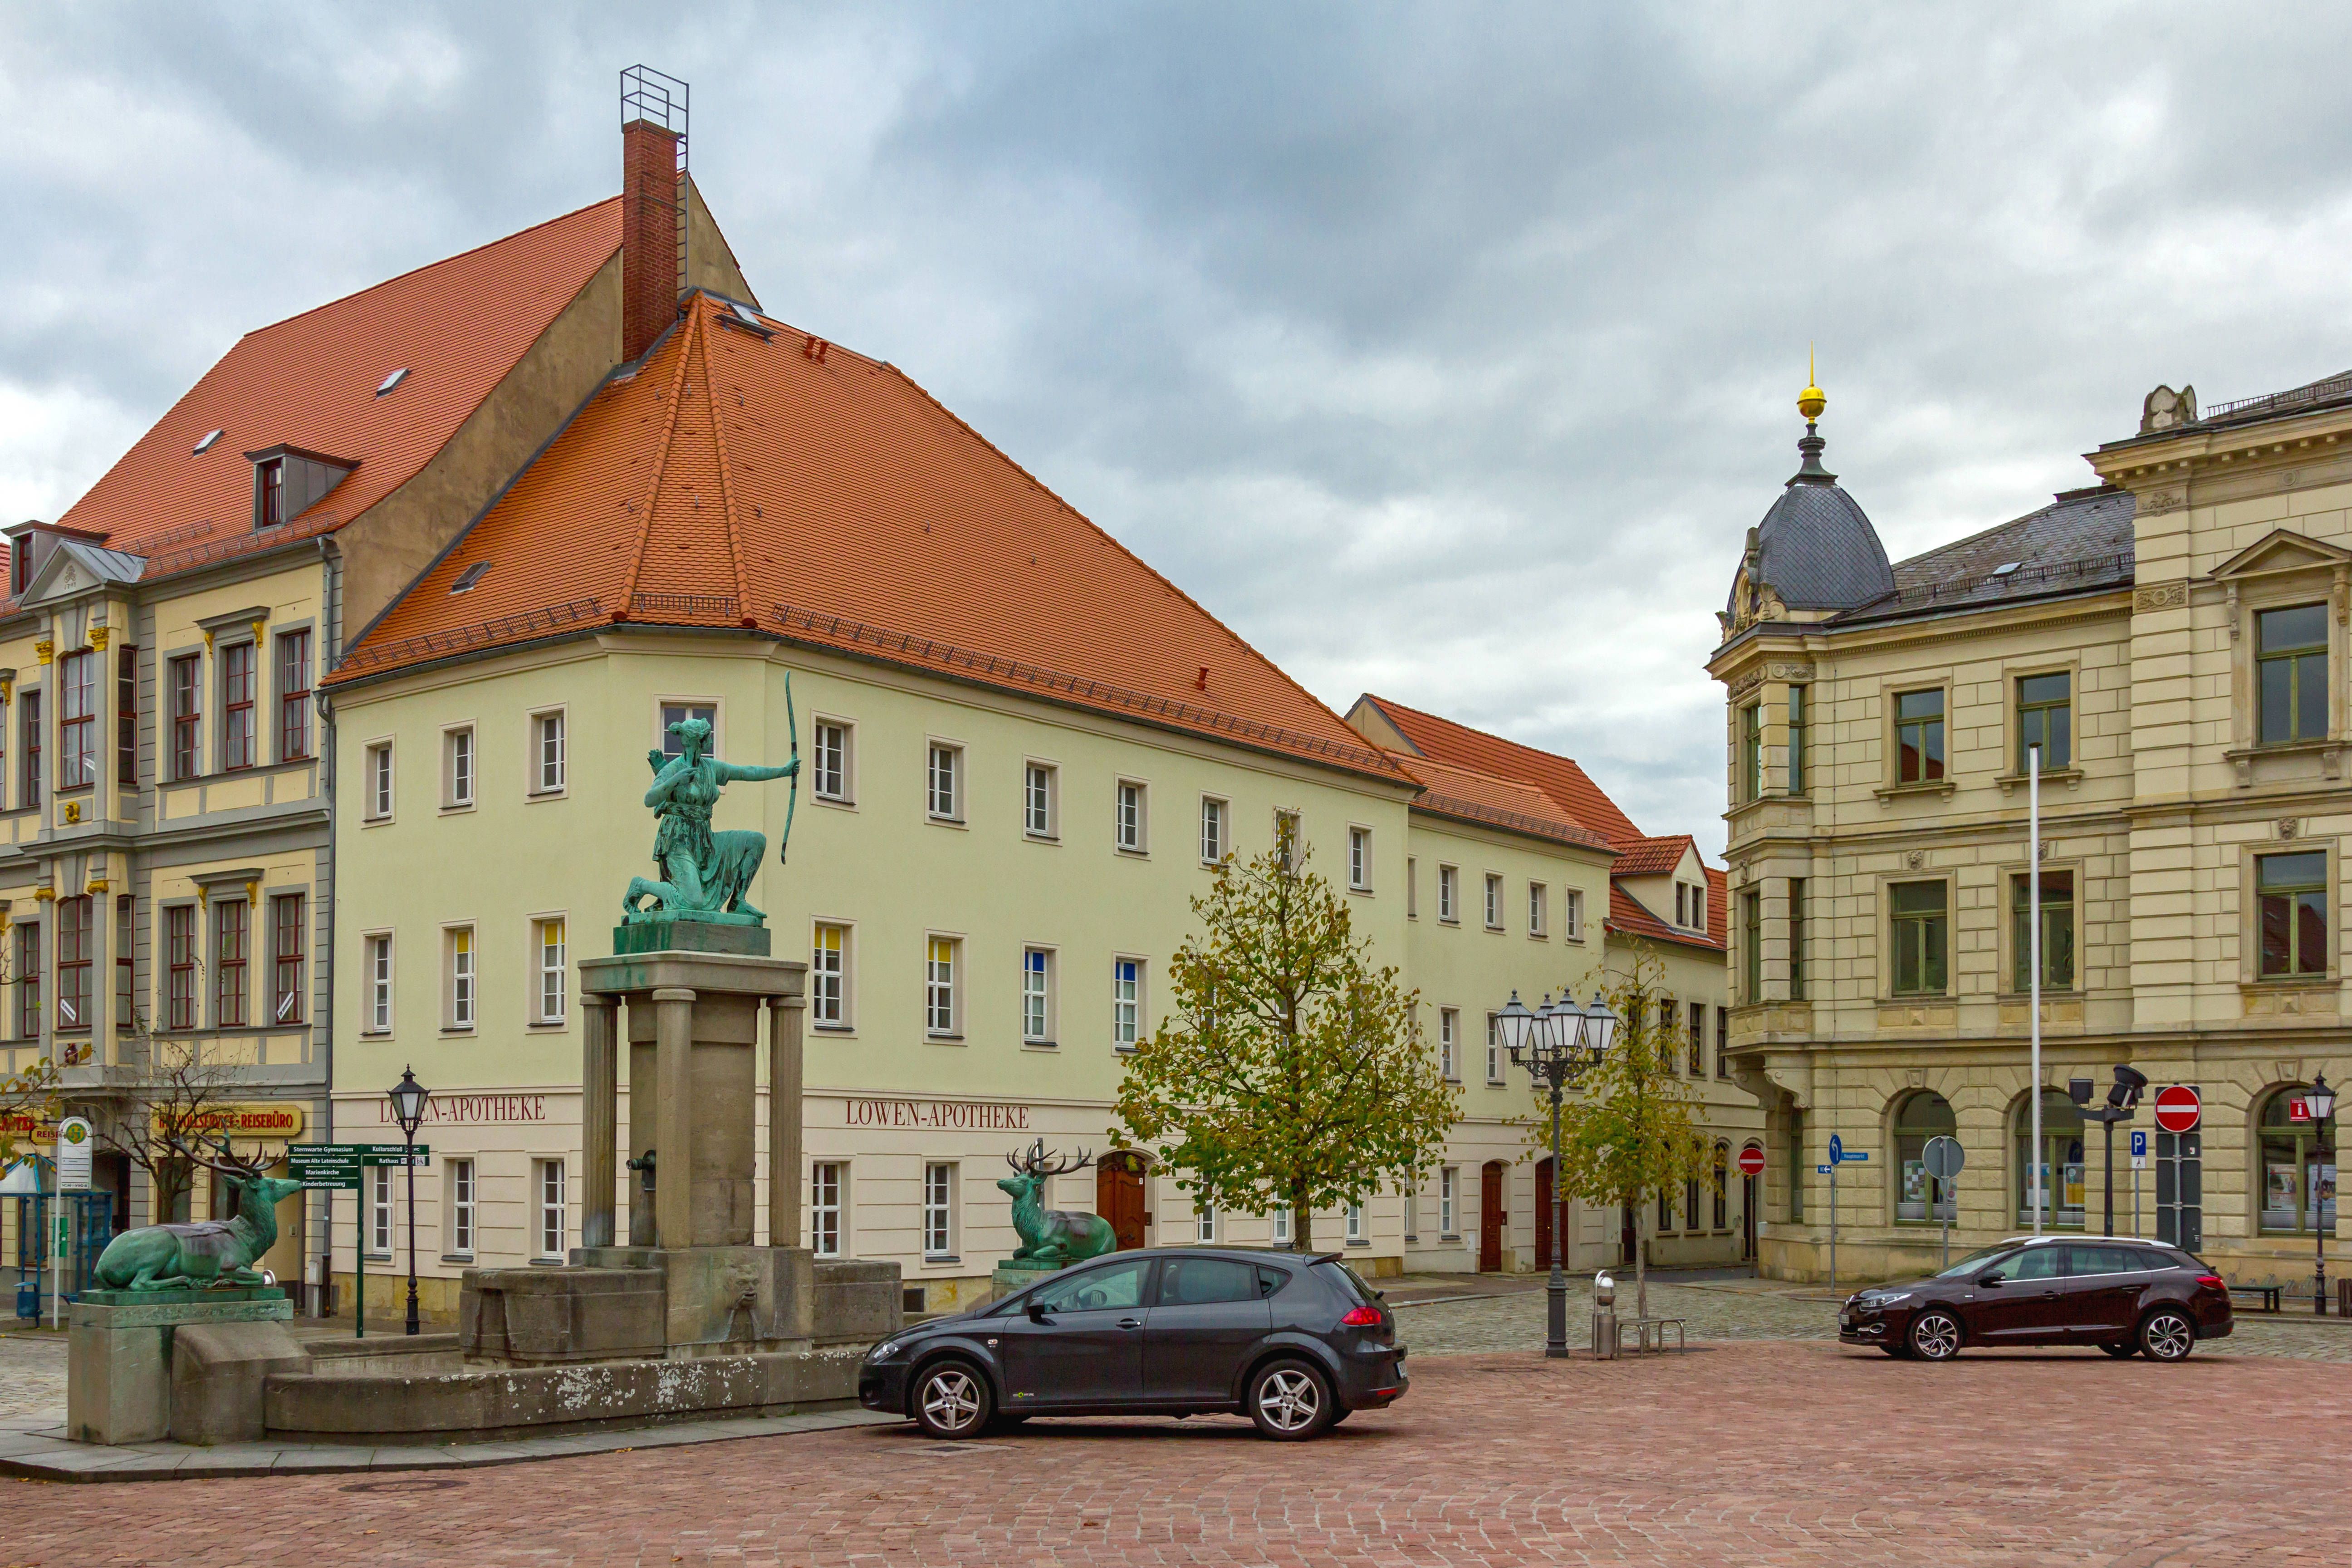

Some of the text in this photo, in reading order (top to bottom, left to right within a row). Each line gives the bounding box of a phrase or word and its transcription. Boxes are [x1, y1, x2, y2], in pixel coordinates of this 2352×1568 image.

[241, 1111, 293, 1128] REISEBÜRO
[845, 1100, 1029, 1129] LÖWEN-APOTHEKE
[2135, 1135, 2143, 1152] P
